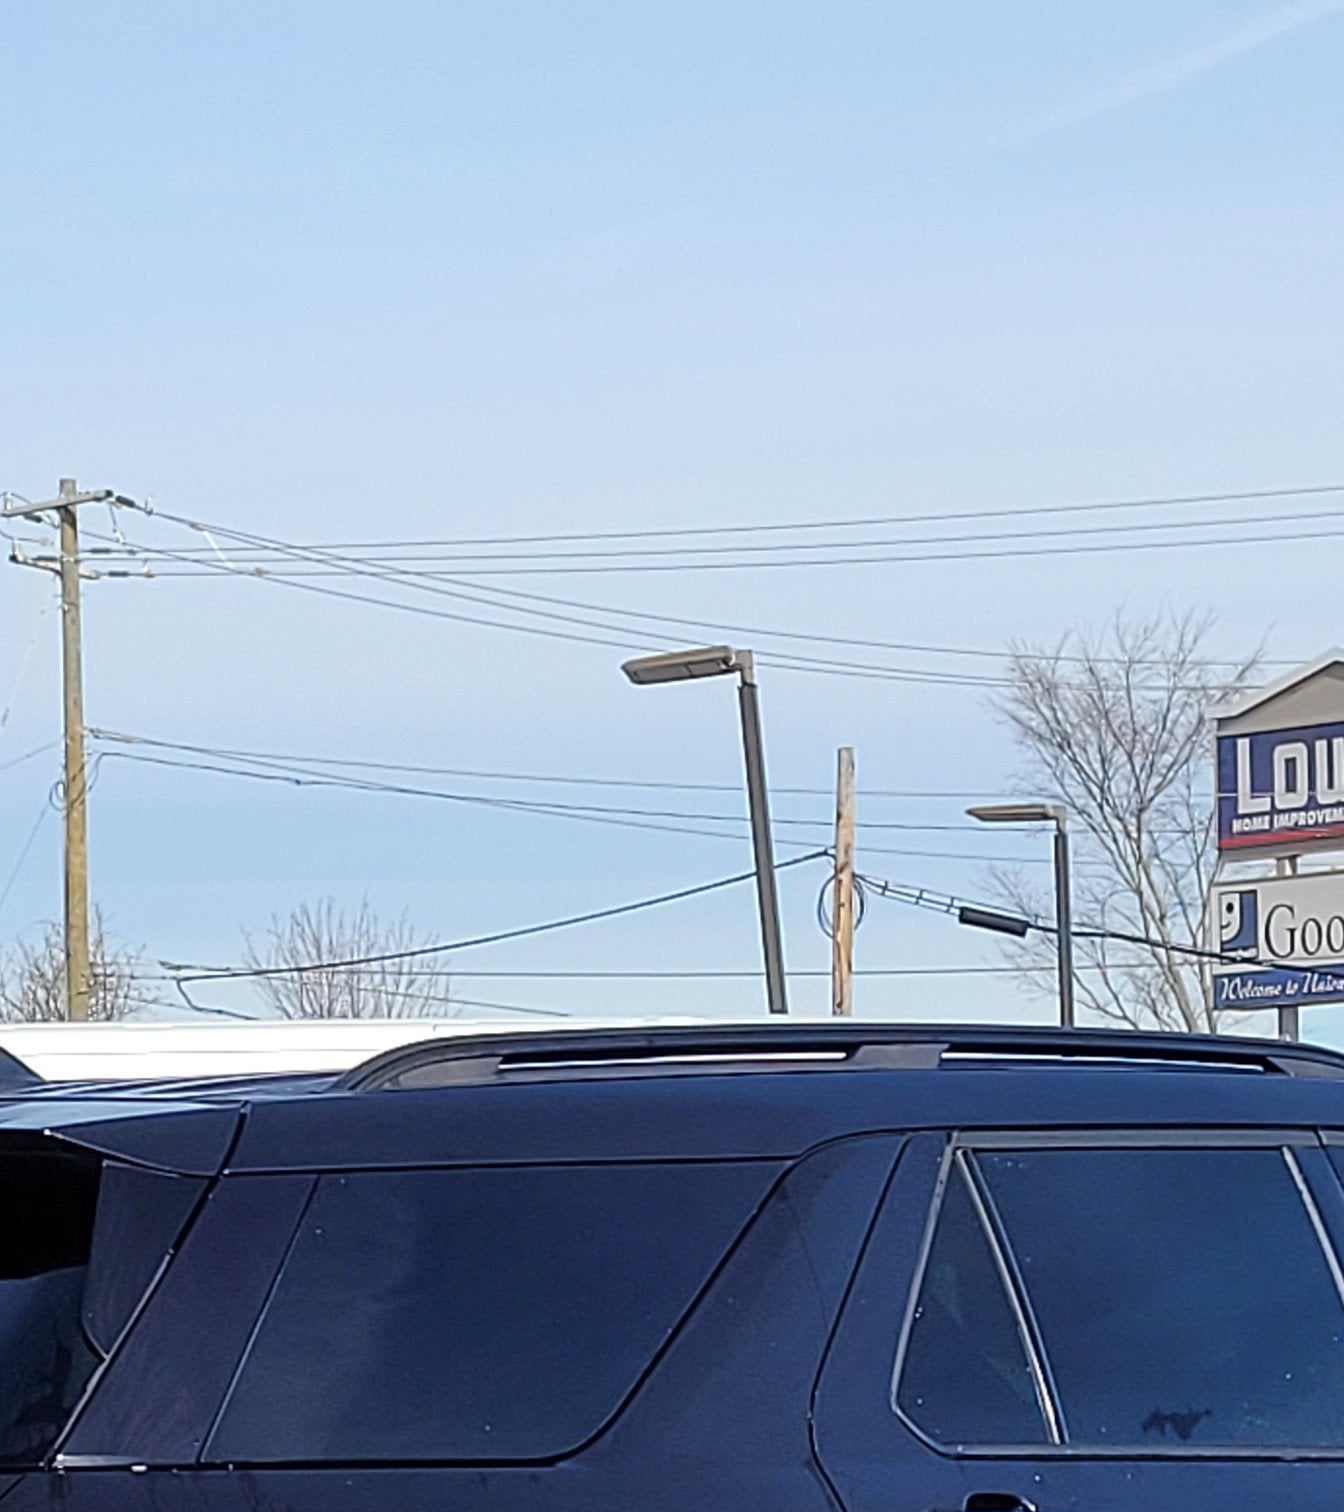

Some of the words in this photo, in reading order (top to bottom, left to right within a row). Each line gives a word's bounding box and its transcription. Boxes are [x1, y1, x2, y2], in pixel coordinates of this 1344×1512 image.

[1232, 815, 1270, 834] HOME
[1220, 976, 1282, 1001] Welcome
[1285, 980, 1299, 995] to
